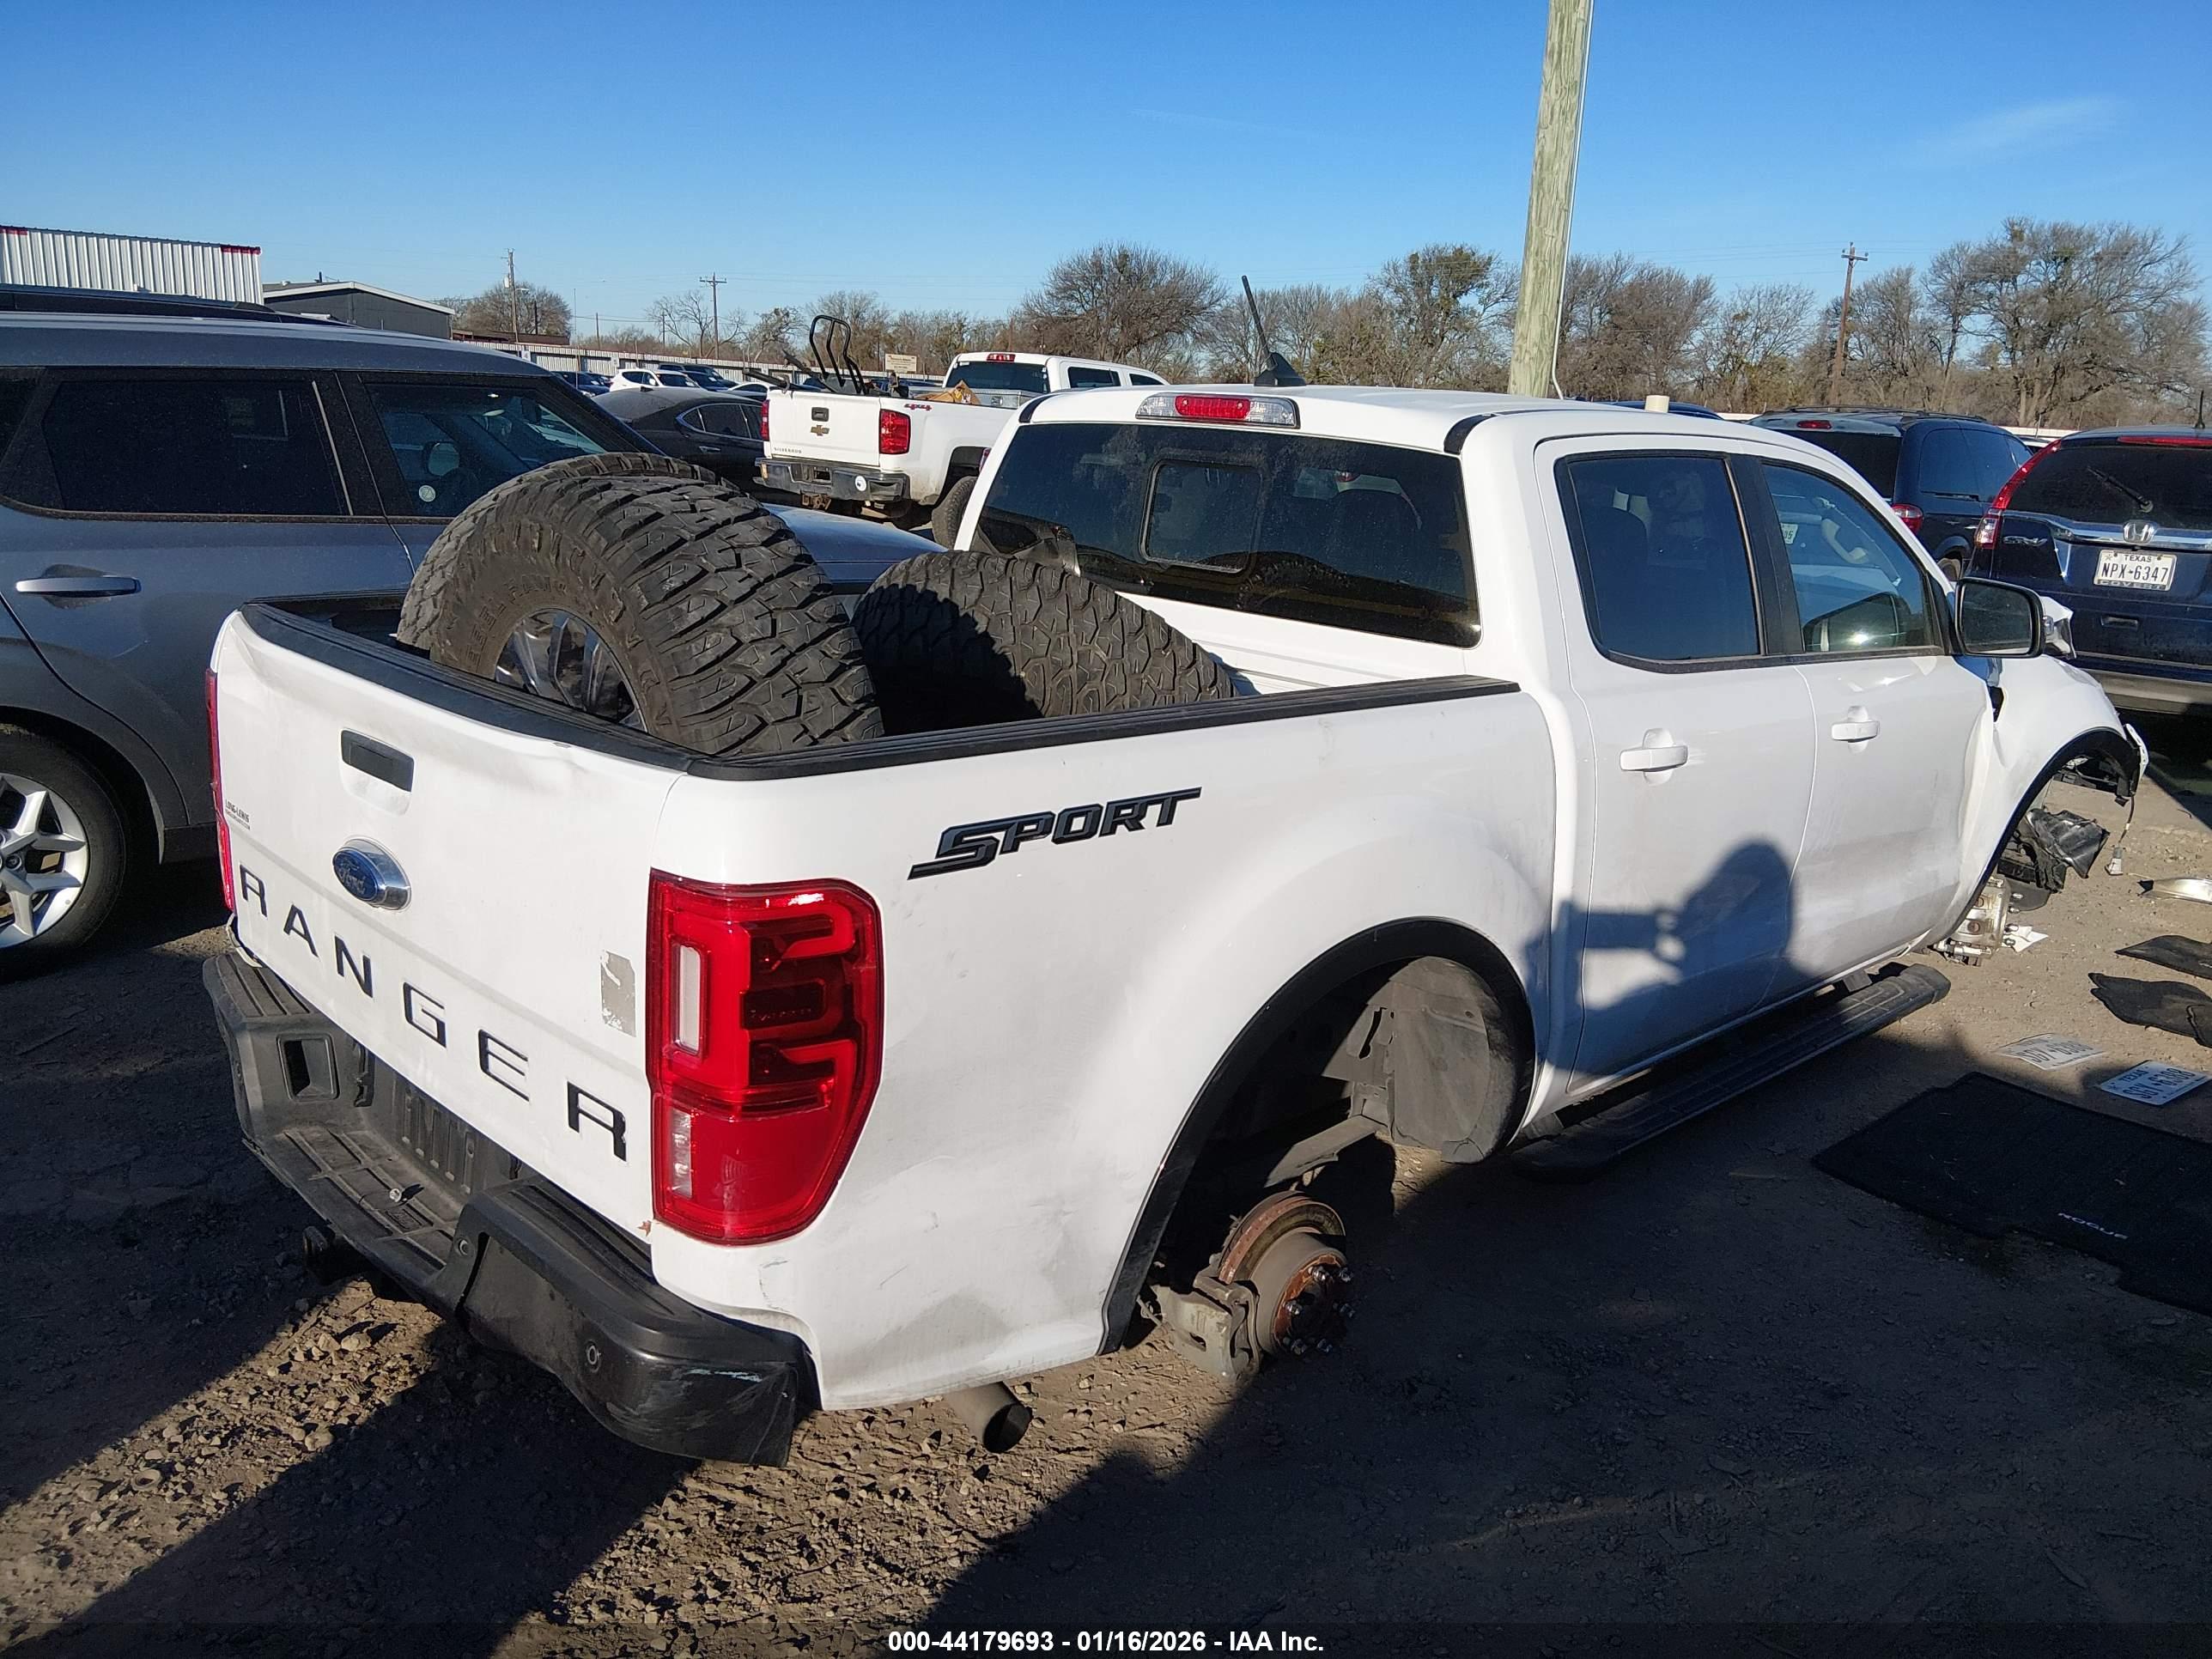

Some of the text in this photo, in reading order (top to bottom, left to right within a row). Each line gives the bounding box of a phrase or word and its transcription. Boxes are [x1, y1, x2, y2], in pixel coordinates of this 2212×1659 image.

[2124, 554, 2153, 563] TEXAS
[907, 786, 1203, 881] SPORT
[240, 864, 627, 1163] RANGER
[2117, 1069, 2149, 1083] TEXAS
[2058, 1212, 2128, 1239] ROGUE
